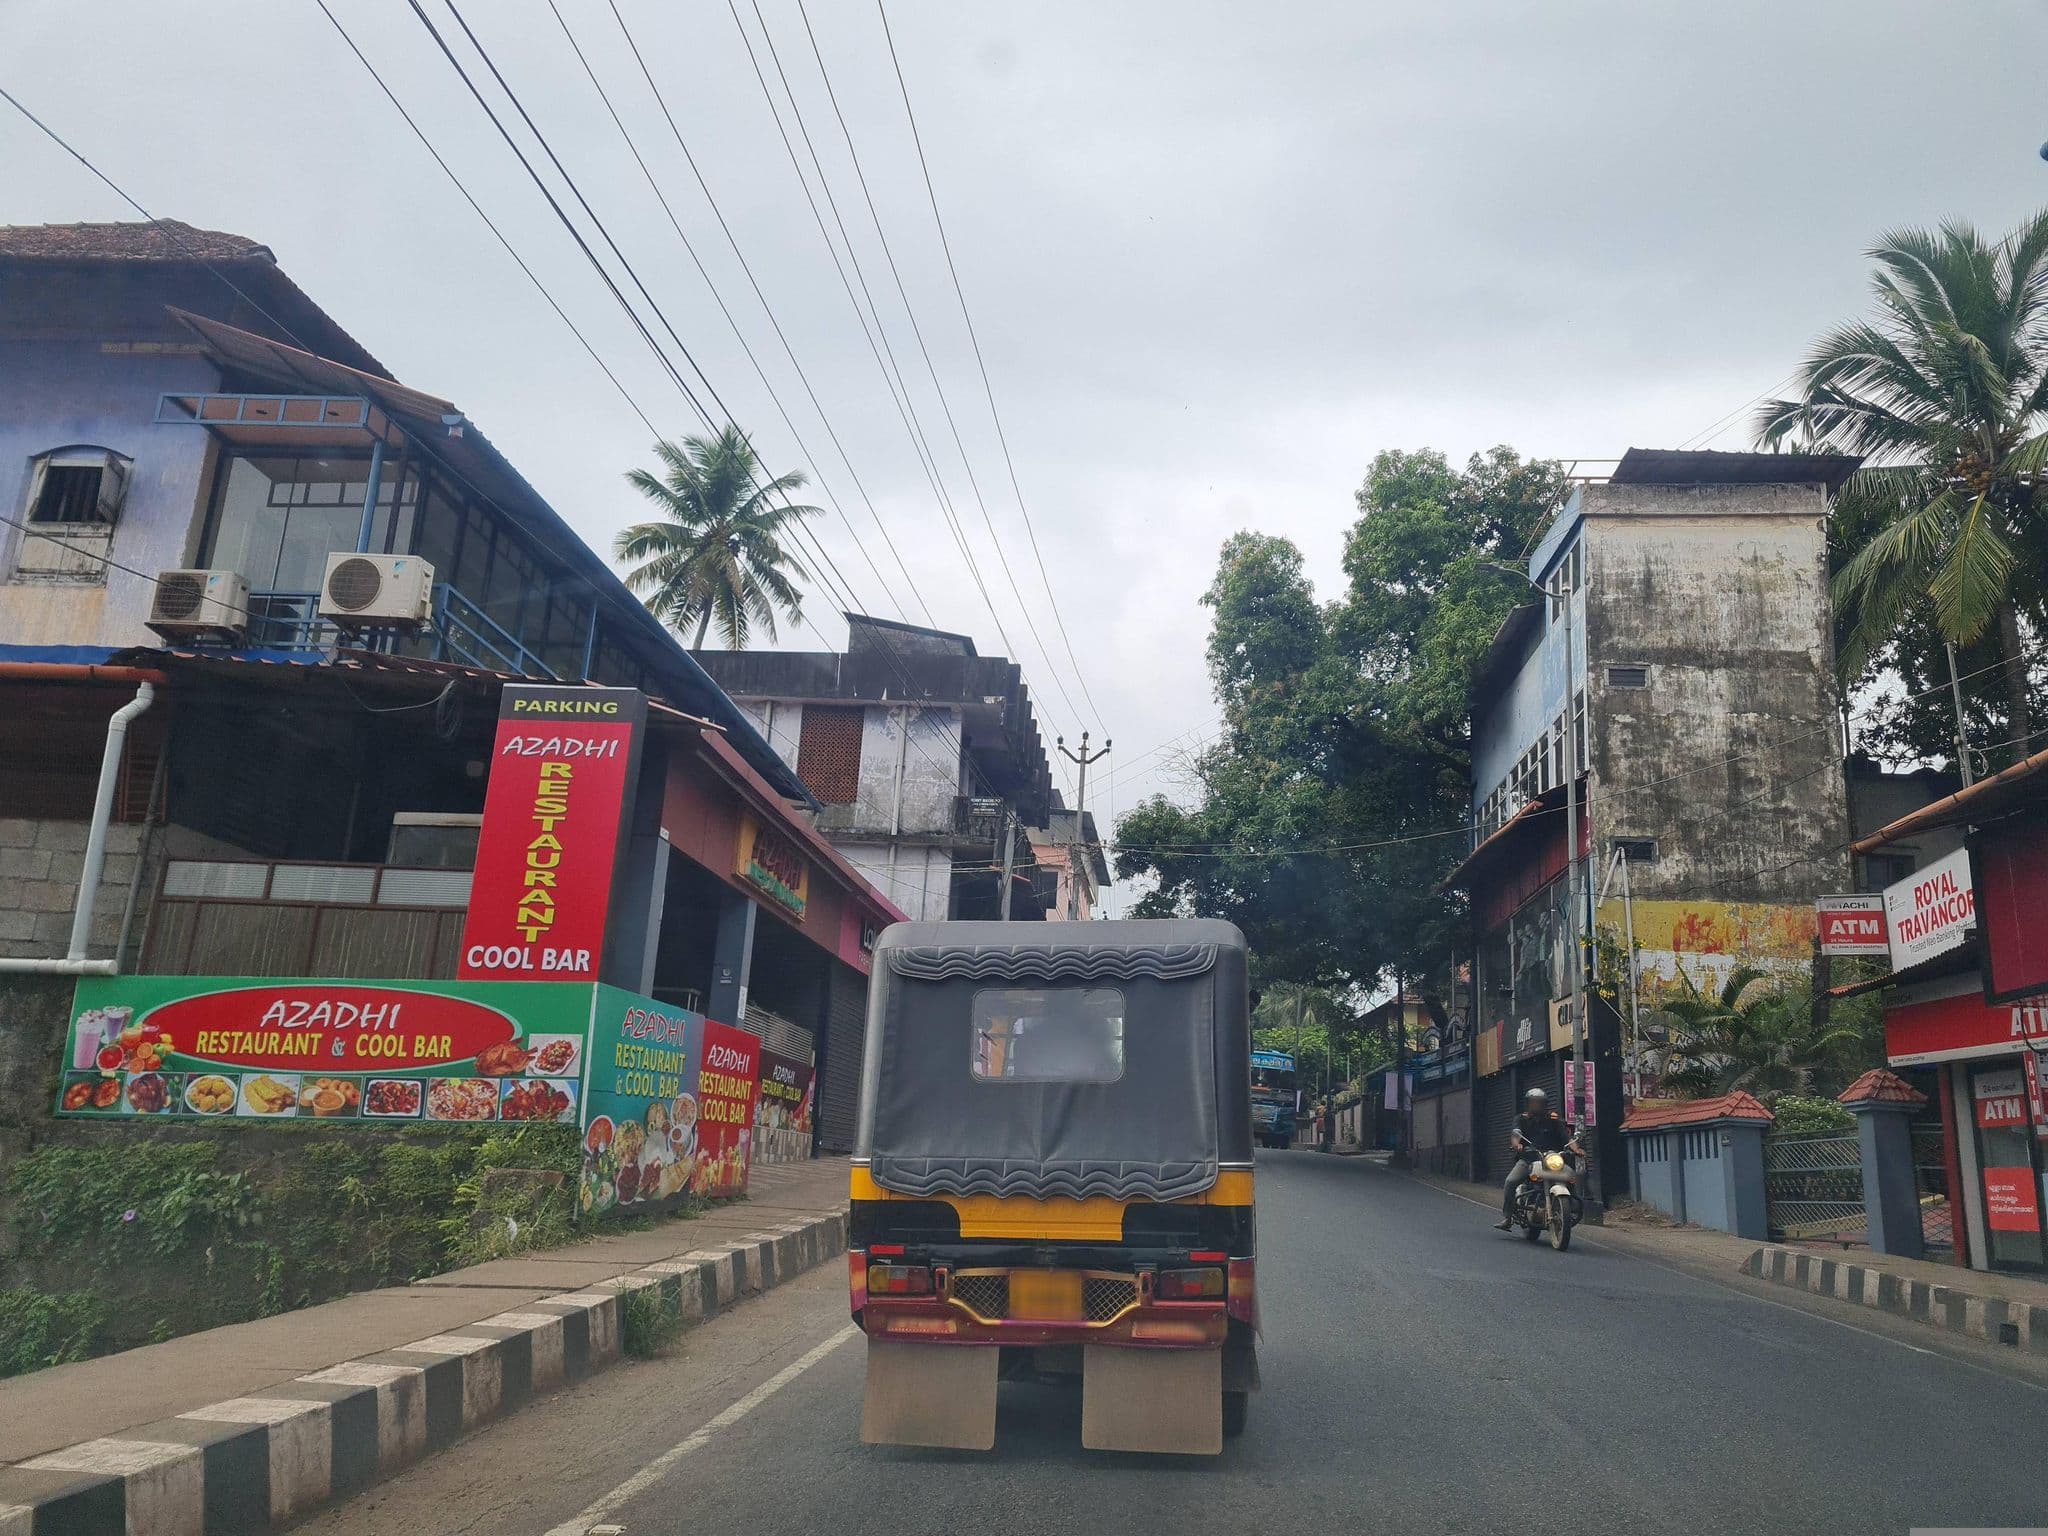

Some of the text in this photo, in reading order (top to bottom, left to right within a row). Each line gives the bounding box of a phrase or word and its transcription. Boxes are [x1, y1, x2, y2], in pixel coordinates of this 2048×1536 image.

[513, 699, 618, 715] PARKING
[502, 735, 619, 758] AZADHI
[516, 761, 574, 943] RESTAURANT
[1913, 869, 1959, 911] ROYAL
[1829, 919, 1880, 935] ATM
[466, 945, 591, 972] COOL BAR
[260, 999, 401, 1031] AZADHI
[621, 1006, 686, 1047] AZADHI
[195, 1030, 452, 1058] RESTAURANT & COOL BAR
[614, 1042, 687, 1075] RESTAURANT
[706, 1043, 751, 1074] AZADHI
[625, 1071, 655, 1097] COOL
[658, 1075, 680, 1099] BAR
[698, 1070, 753, 1101] RESTAURANT
[772, 1064, 796, 1085] AZADHI
[2028, 1060, 2041, 1116] ATM
[704, 1098, 728, 1123] COOL
[729, 1102, 746, 1125] BAR
[1984, 1098, 2021, 1121] ATM
